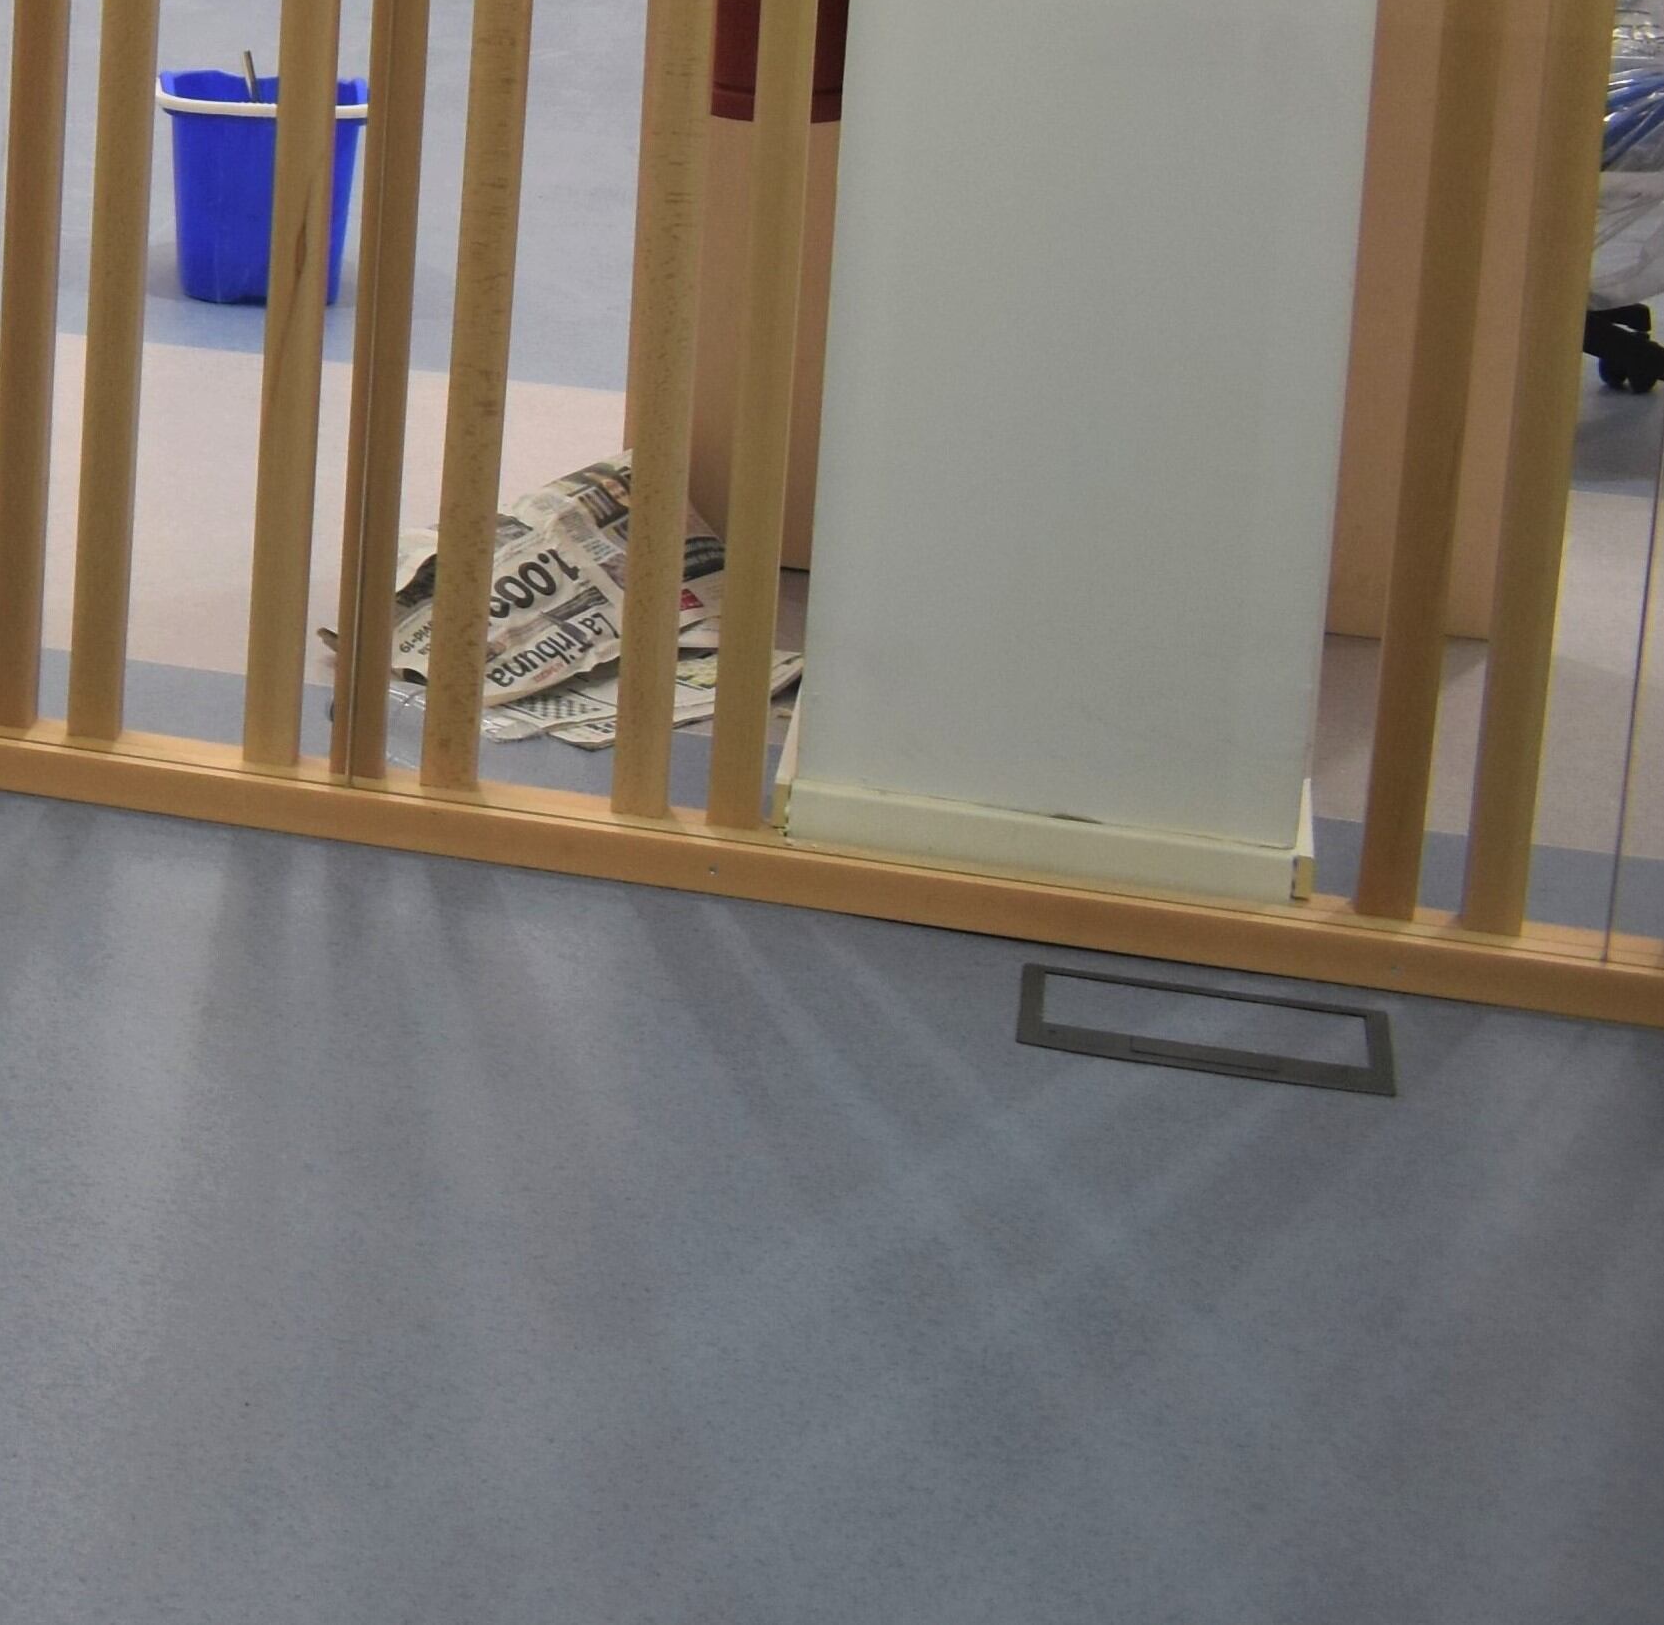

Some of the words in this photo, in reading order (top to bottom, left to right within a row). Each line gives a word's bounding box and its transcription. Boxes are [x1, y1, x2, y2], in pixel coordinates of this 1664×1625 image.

[399, 620, 433, 653] vid-19
[579, 612, 620, 639] La
[486, 626, 594, 688] Tribuna
